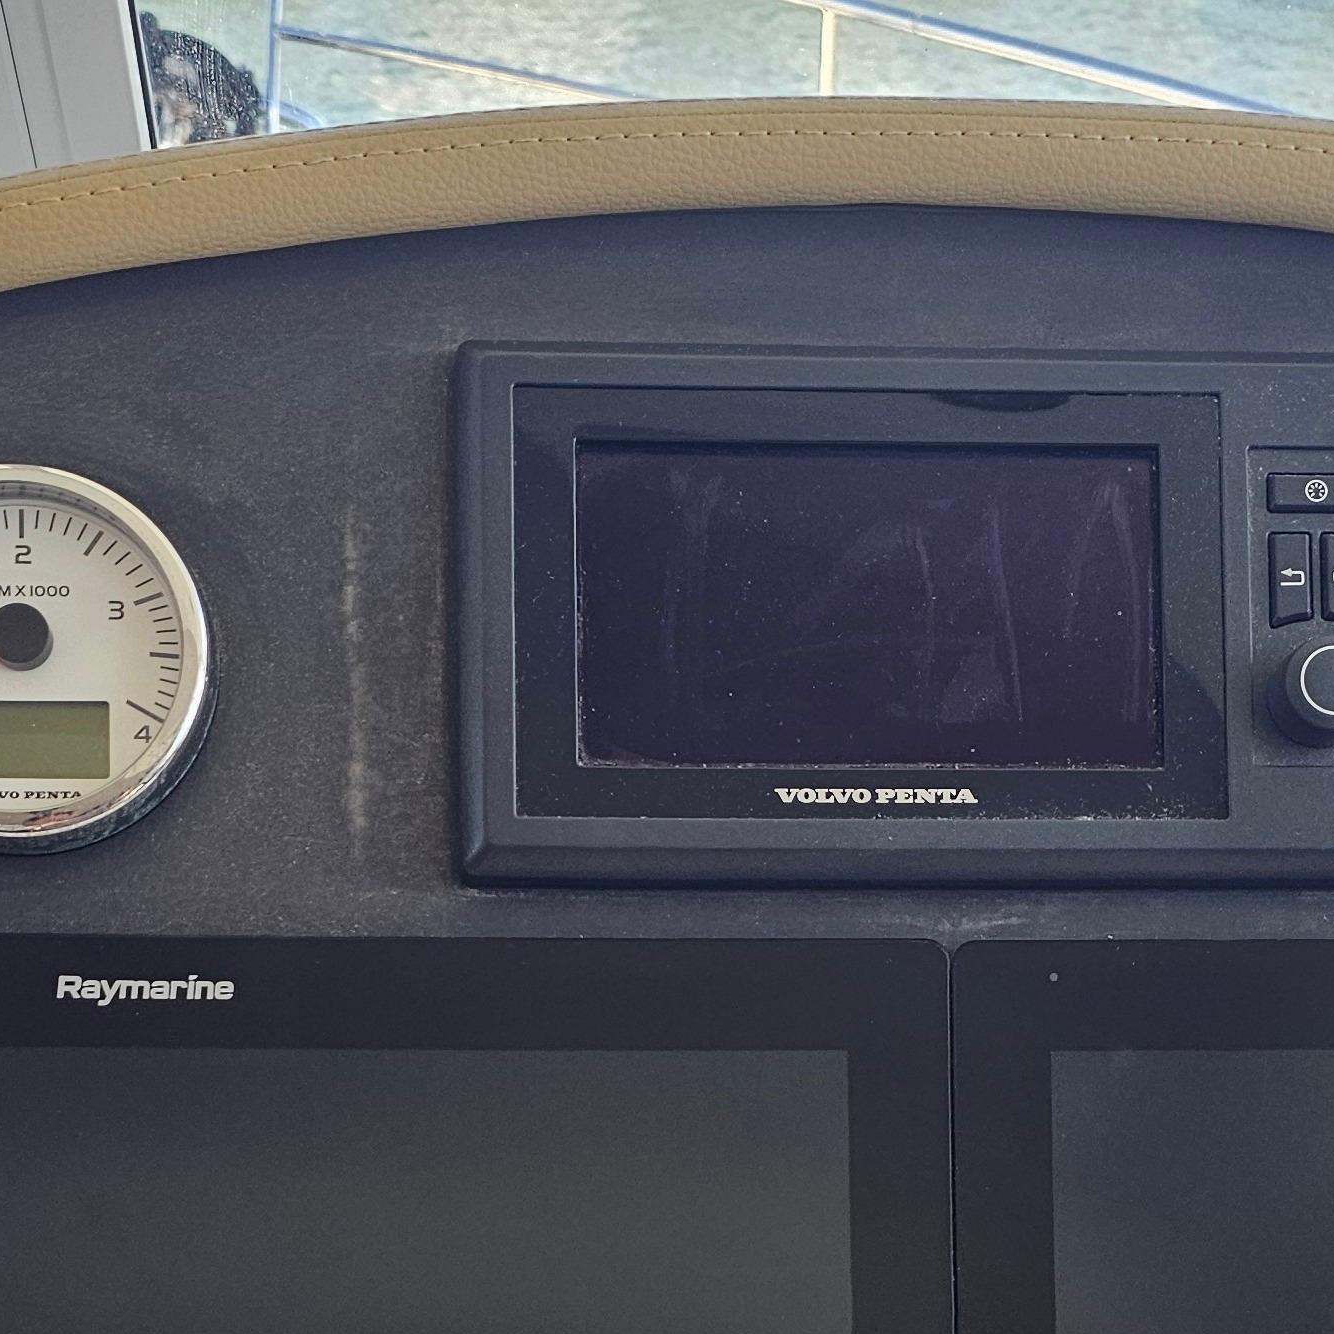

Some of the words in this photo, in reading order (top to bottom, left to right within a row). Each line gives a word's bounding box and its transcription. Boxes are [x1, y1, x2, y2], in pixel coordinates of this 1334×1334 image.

[14, 544, 32, 565] 2
[15, 584, 26, 597] X
[29, 585, 70, 597] 1000
[107, 600, 125, 620] 3
[133, 724, 153, 744] 4
[24, 790, 82, 800] PENTA
[774, 788, 872, 804] VOLVO
[875, 788, 979, 804] PENTA
[56, 974, 235, 1007] Raymarine
